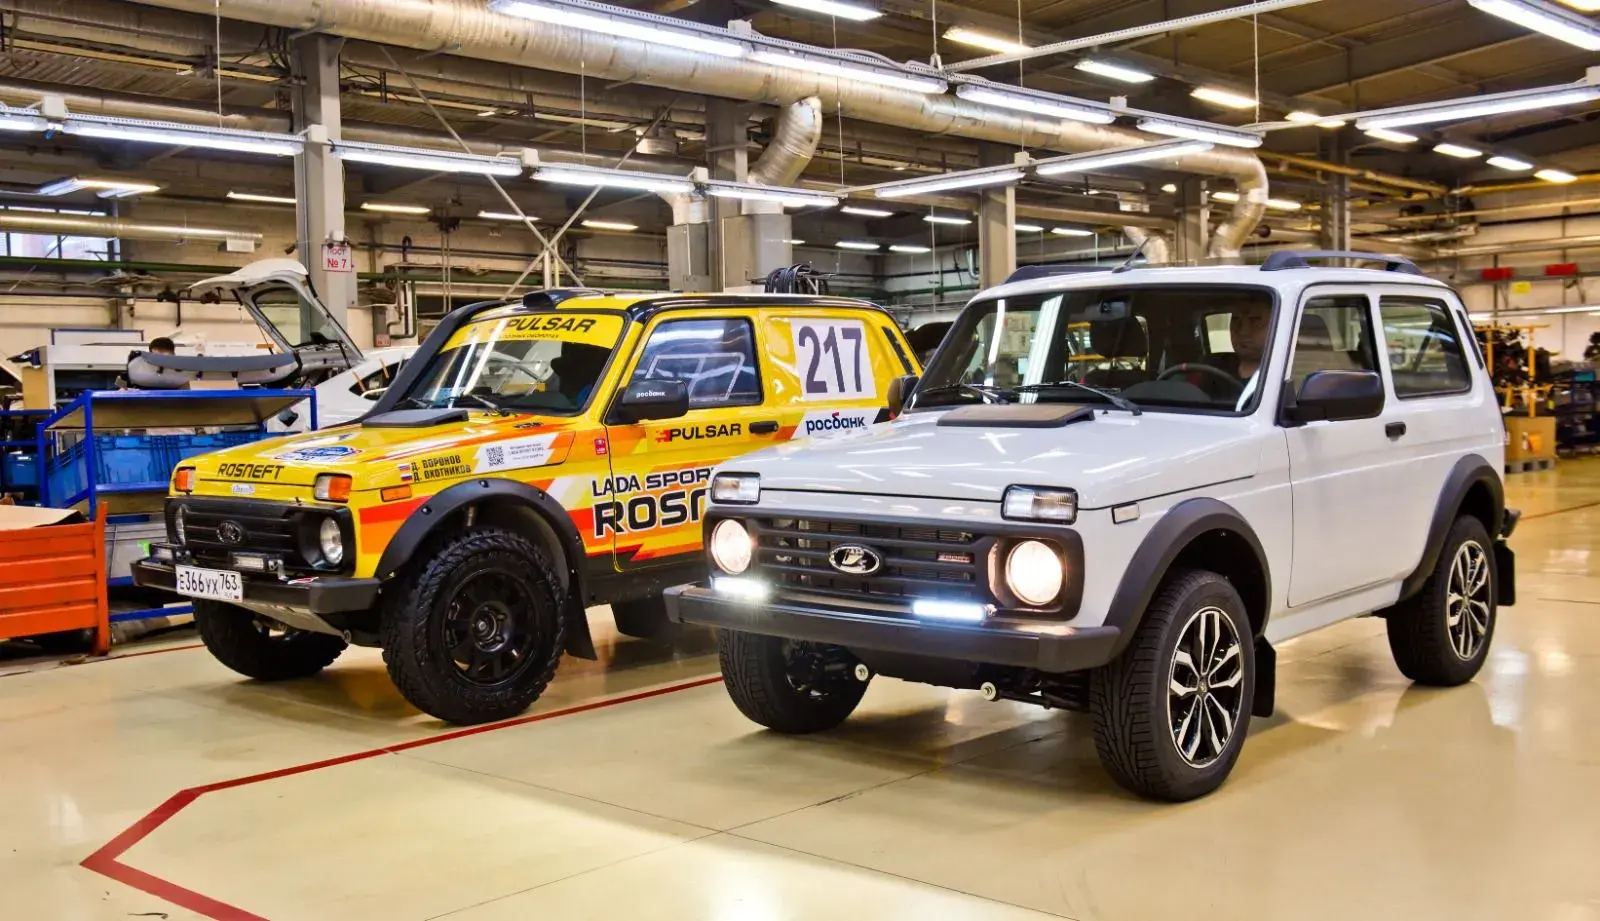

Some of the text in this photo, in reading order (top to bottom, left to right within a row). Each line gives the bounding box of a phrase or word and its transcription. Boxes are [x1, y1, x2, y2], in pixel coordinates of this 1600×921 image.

[341, 258, 347, 268] 7
[506, 317, 597, 333] PULSAR
[798, 325, 862, 394] 217
[670, 423, 742, 442] PULSAR
[806, 411, 866, 435] росбанк
[217, 463, 285, 480] ROSNEFT
[592, 467, 714, 496] LADA SPOR
